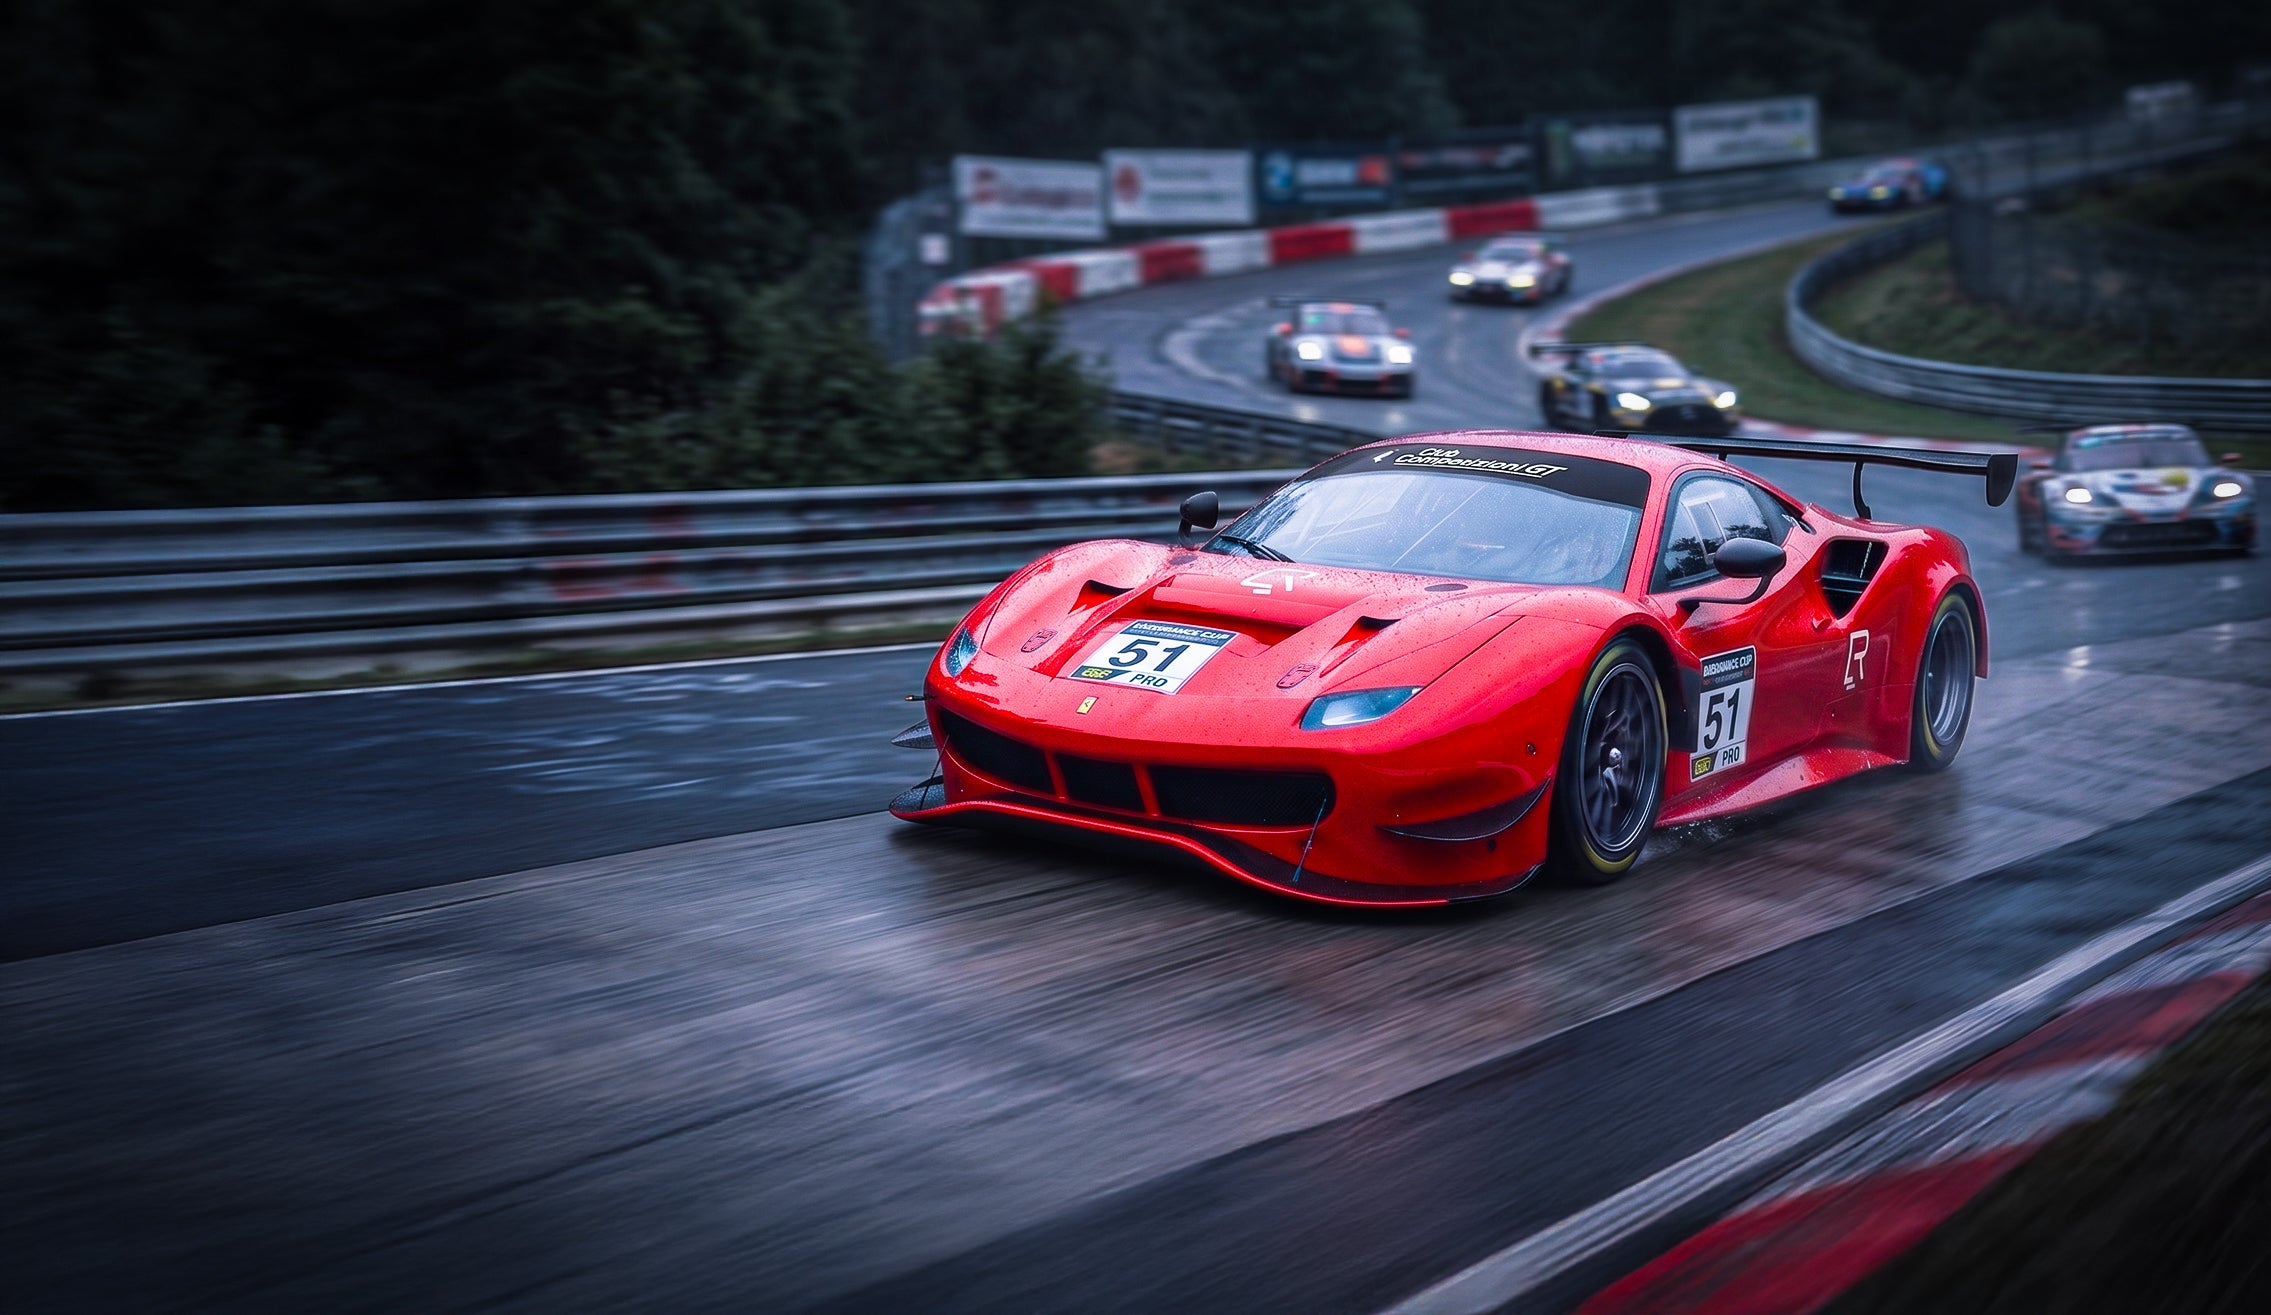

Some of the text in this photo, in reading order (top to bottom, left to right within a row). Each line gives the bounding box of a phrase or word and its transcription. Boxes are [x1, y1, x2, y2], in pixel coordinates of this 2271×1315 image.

[1418, 447, 1460, 458] Club
[1200, 631, 1231, 640] CUP
[1108, 638, 1190, 672] 51
[1129, 673, 1168, 687] PRO
[1703, 687, 1740, 750] 51
[1721, 746, 1740, 766] PRO
